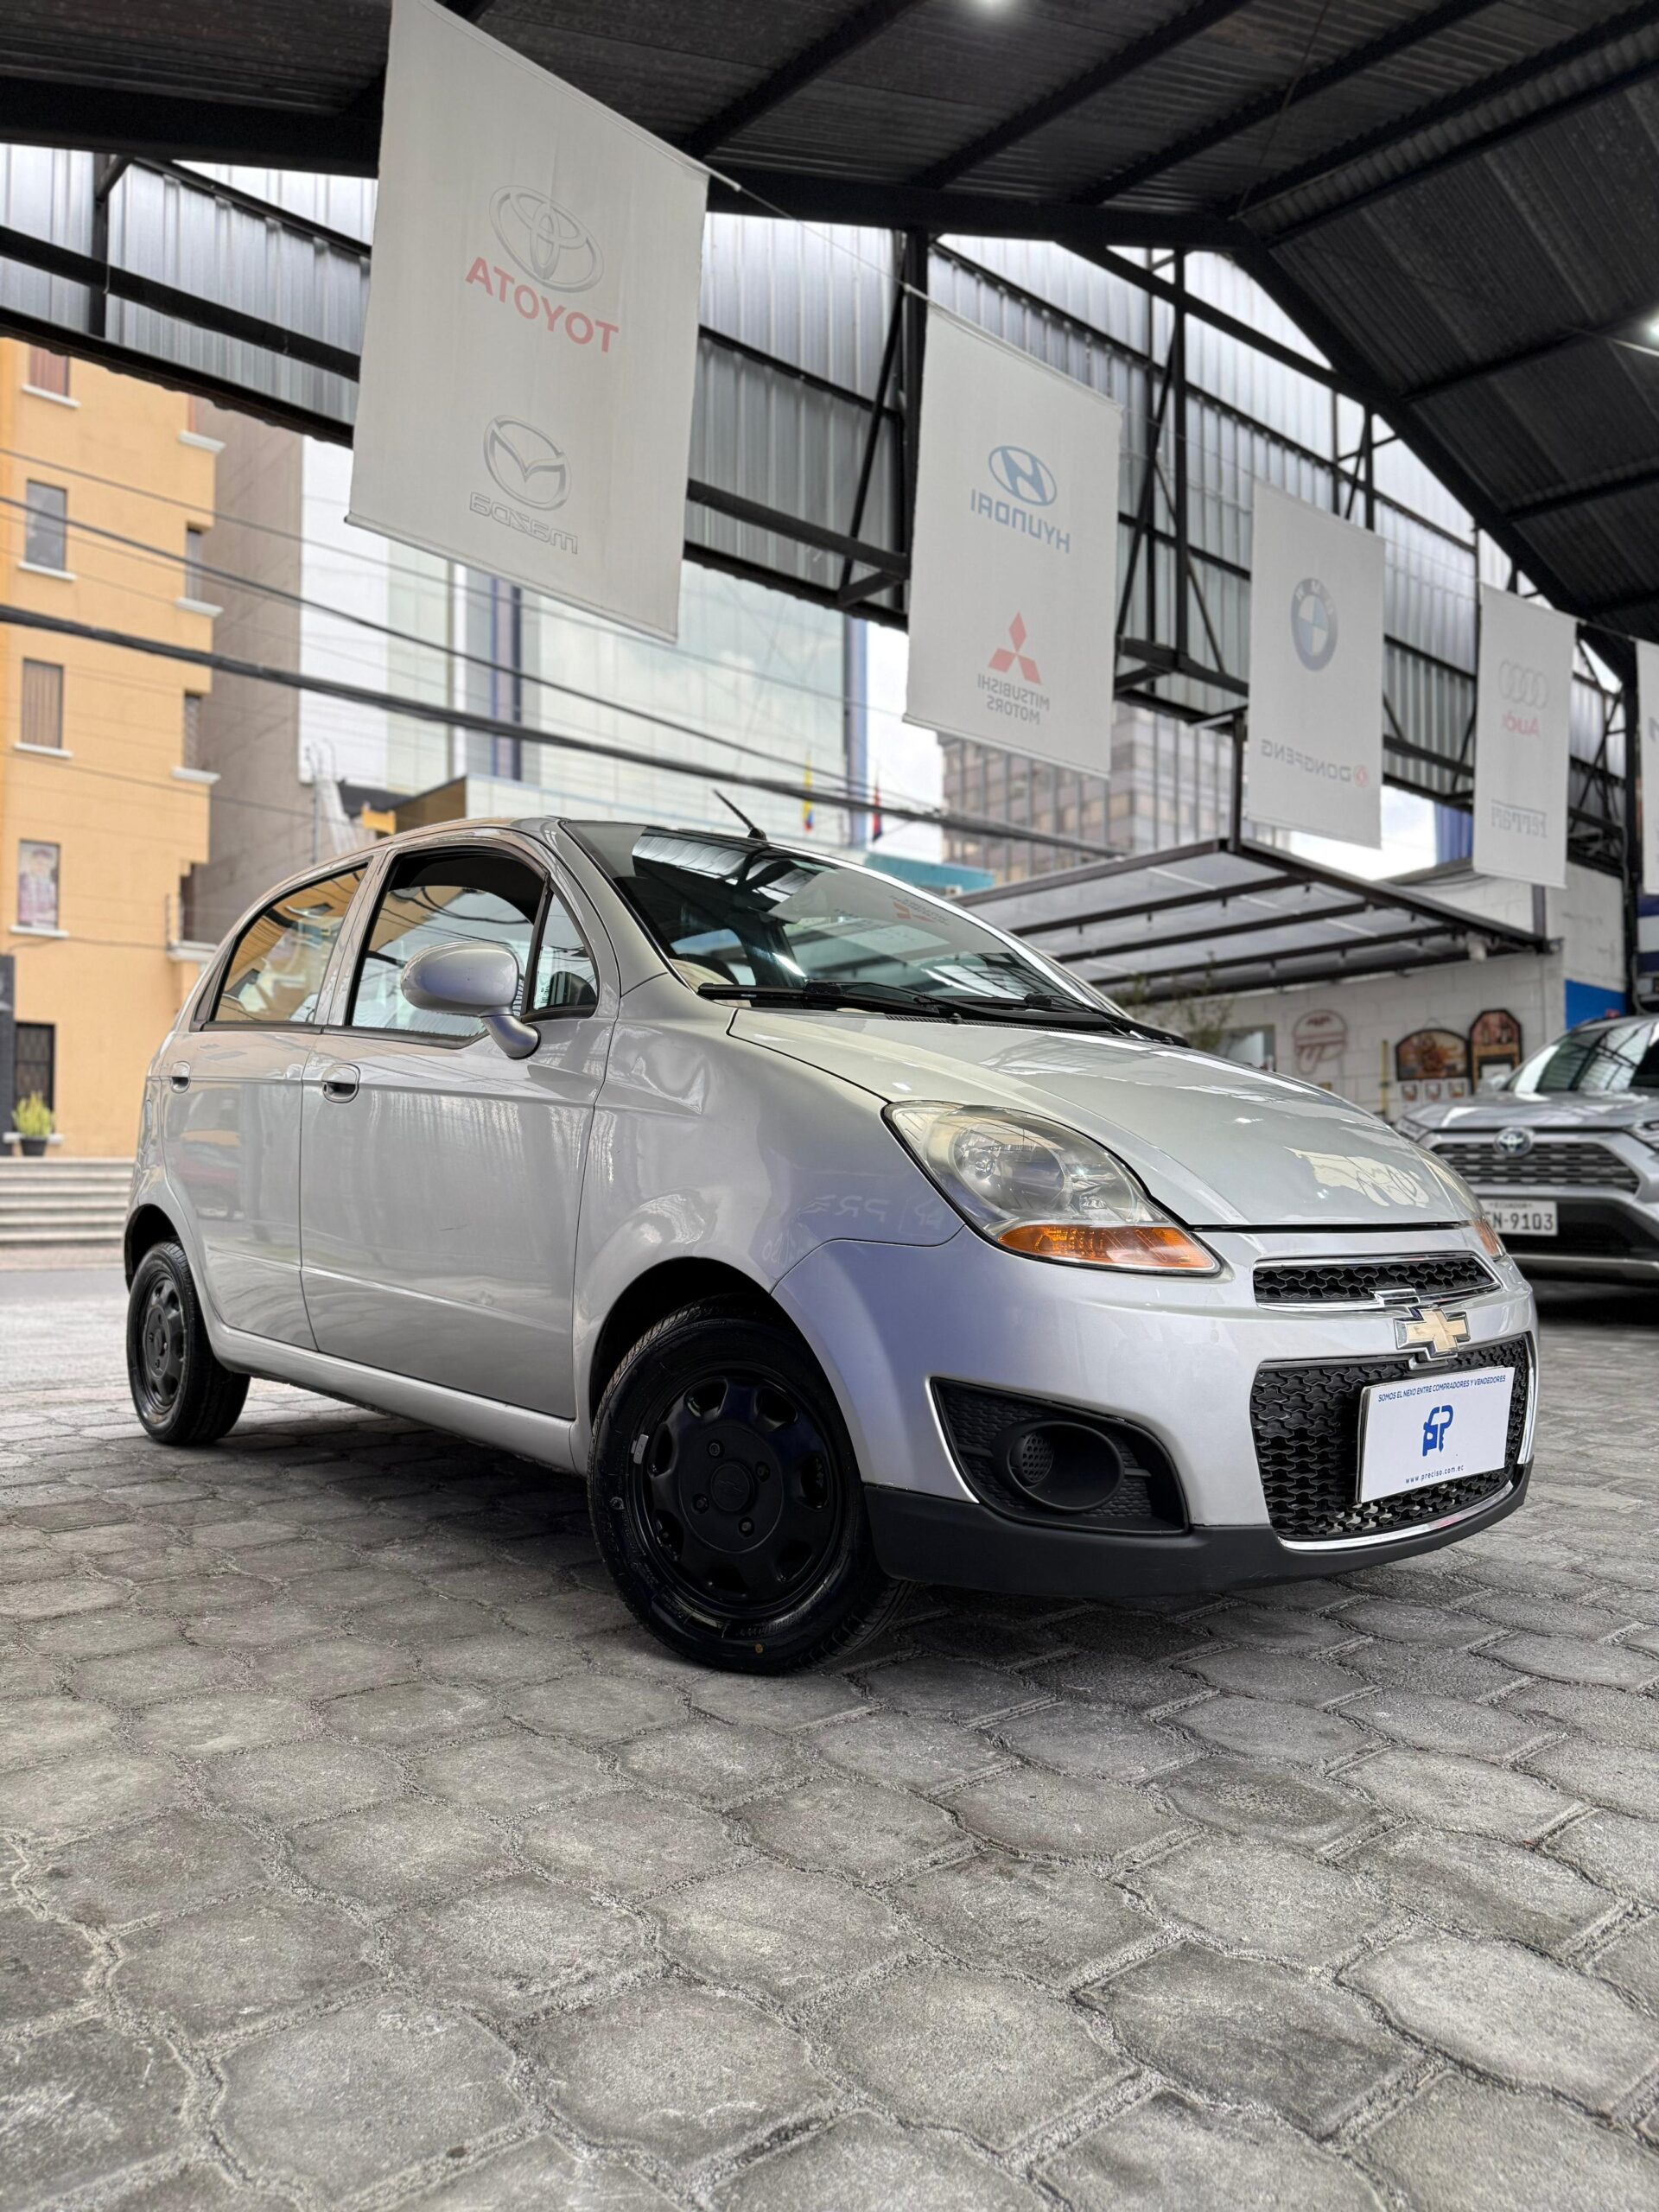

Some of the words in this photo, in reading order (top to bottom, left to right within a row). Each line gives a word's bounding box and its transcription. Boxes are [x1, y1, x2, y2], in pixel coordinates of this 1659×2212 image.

[1484, 1211, 1554, 1230] N-9103
[1378, 1390, 1396, 1402] SOMOS
[1397, 1389, 1403, 1399] EL
[1403, 1387, 1417, 1397] NEXO
[1417, 1385, 1433, 1395] ENTRE
[1433, 1379, 1470, 1392] COMPRADORES
[1473, 1375, 1506, 1386] VENDEDORES
[1405, 1465, 1464, 1484] www.preciso.com.ec
